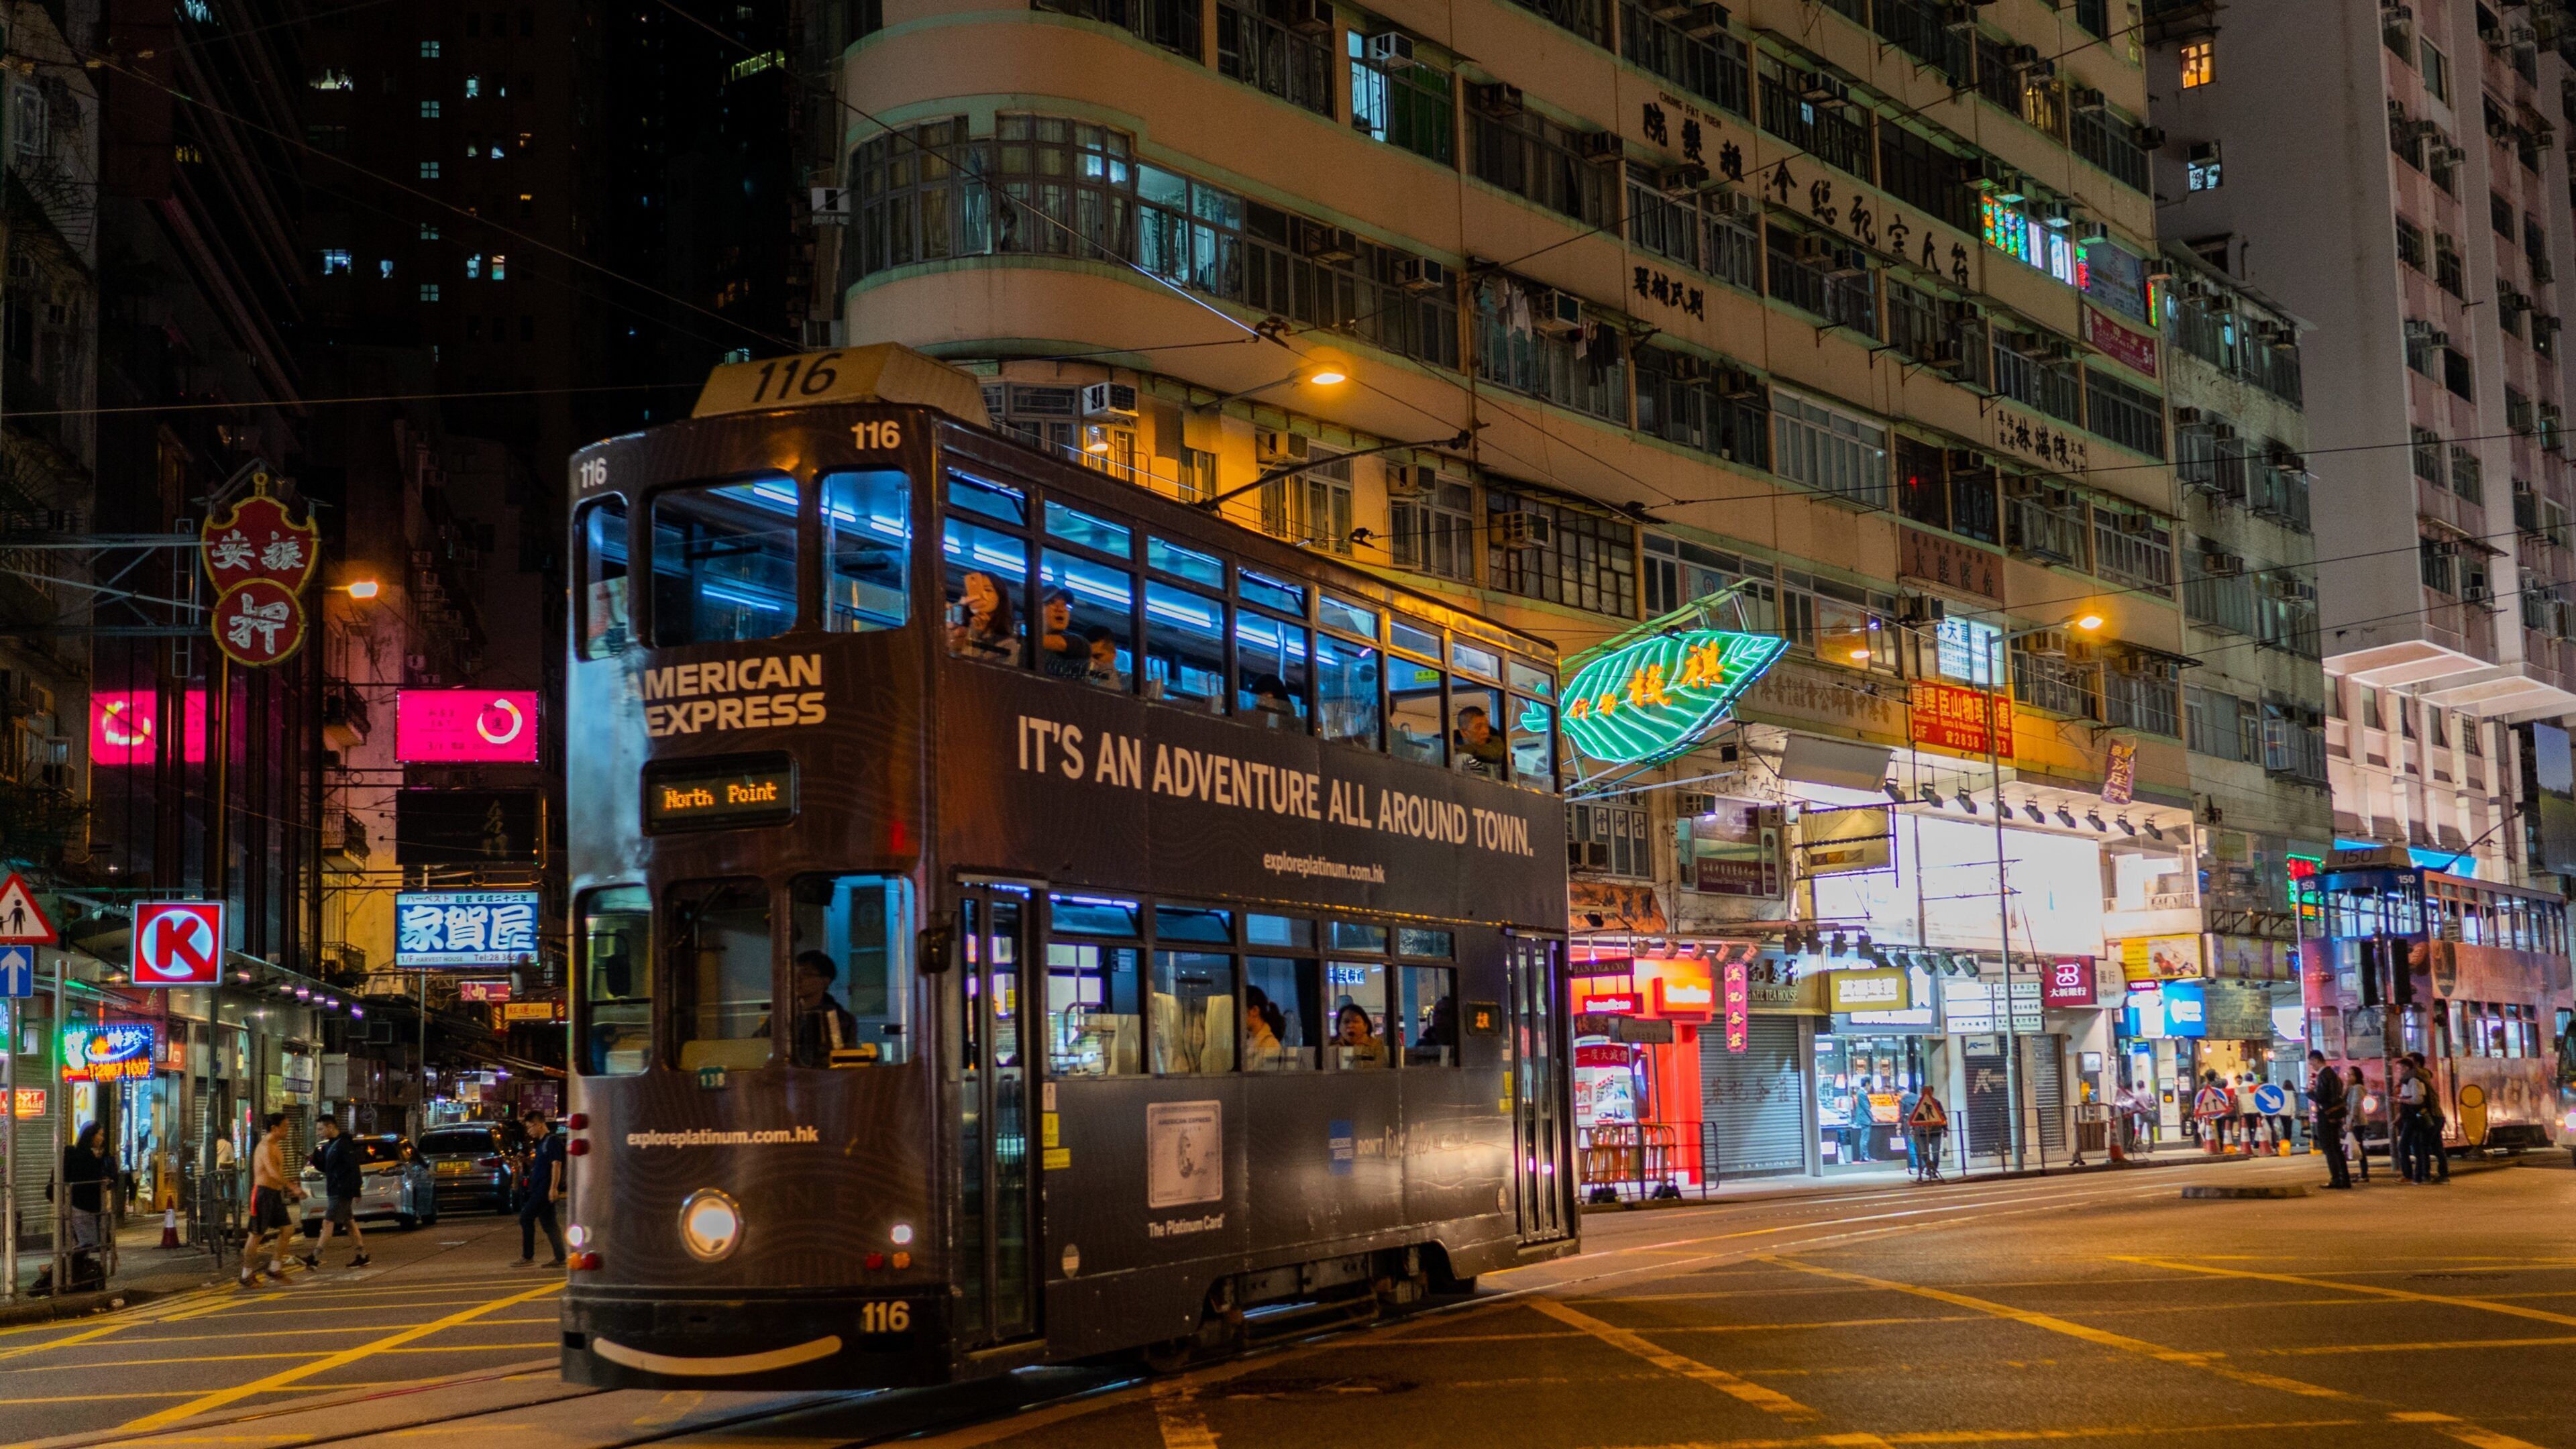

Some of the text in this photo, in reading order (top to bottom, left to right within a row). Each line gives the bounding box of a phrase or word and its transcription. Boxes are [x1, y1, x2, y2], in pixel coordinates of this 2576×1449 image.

[1686, 103, 1700, 119] FAT
[753, 352, 842, 402] 116
[851, 421, 901, 449] 116
[580, 457, 607, 488] 116
[228, 592, 290, 655] 押
[645, 692, 826, 737] EXPRESS
[663, 782, 777, 812] North Point
[1018, 715, 1084, 780] IT'S
[1095, 731, 1143, 790] AN
[1152, 743, 1321, 820] ADVENTURE
[1328, 778, 1373, 829] ALL
[1377, 789, 1468, 845] AROUND
[1472, 807, 1534, 857] TOWN.
[1263, 850, 1386, 884] exploreplatinum.com.hk
[2342, 849, 2373, 864] 150
[2301, 881, 2316, 890] 150
[2397, 874, 2416, 883] 150
[406, 894, 449, 903] ハーベスト
[400, 904, 535, 951] 家賀屋
[156, 916, 204, 974] K
[1752, 989, 1799, 1002] KEE TEA HOUSE
[2049, 986, 2088, 998] 大新銀行
[1575, 1049, 1629, 1063] 一度大減價
[627, 1125, 819, 1148] exploreplatinum.com.hk
[1148, 1222, 1165, 1238] The
[1165, 1218, 1203, 1235] Platinum
[862, 1300, 910, 1334] 116
